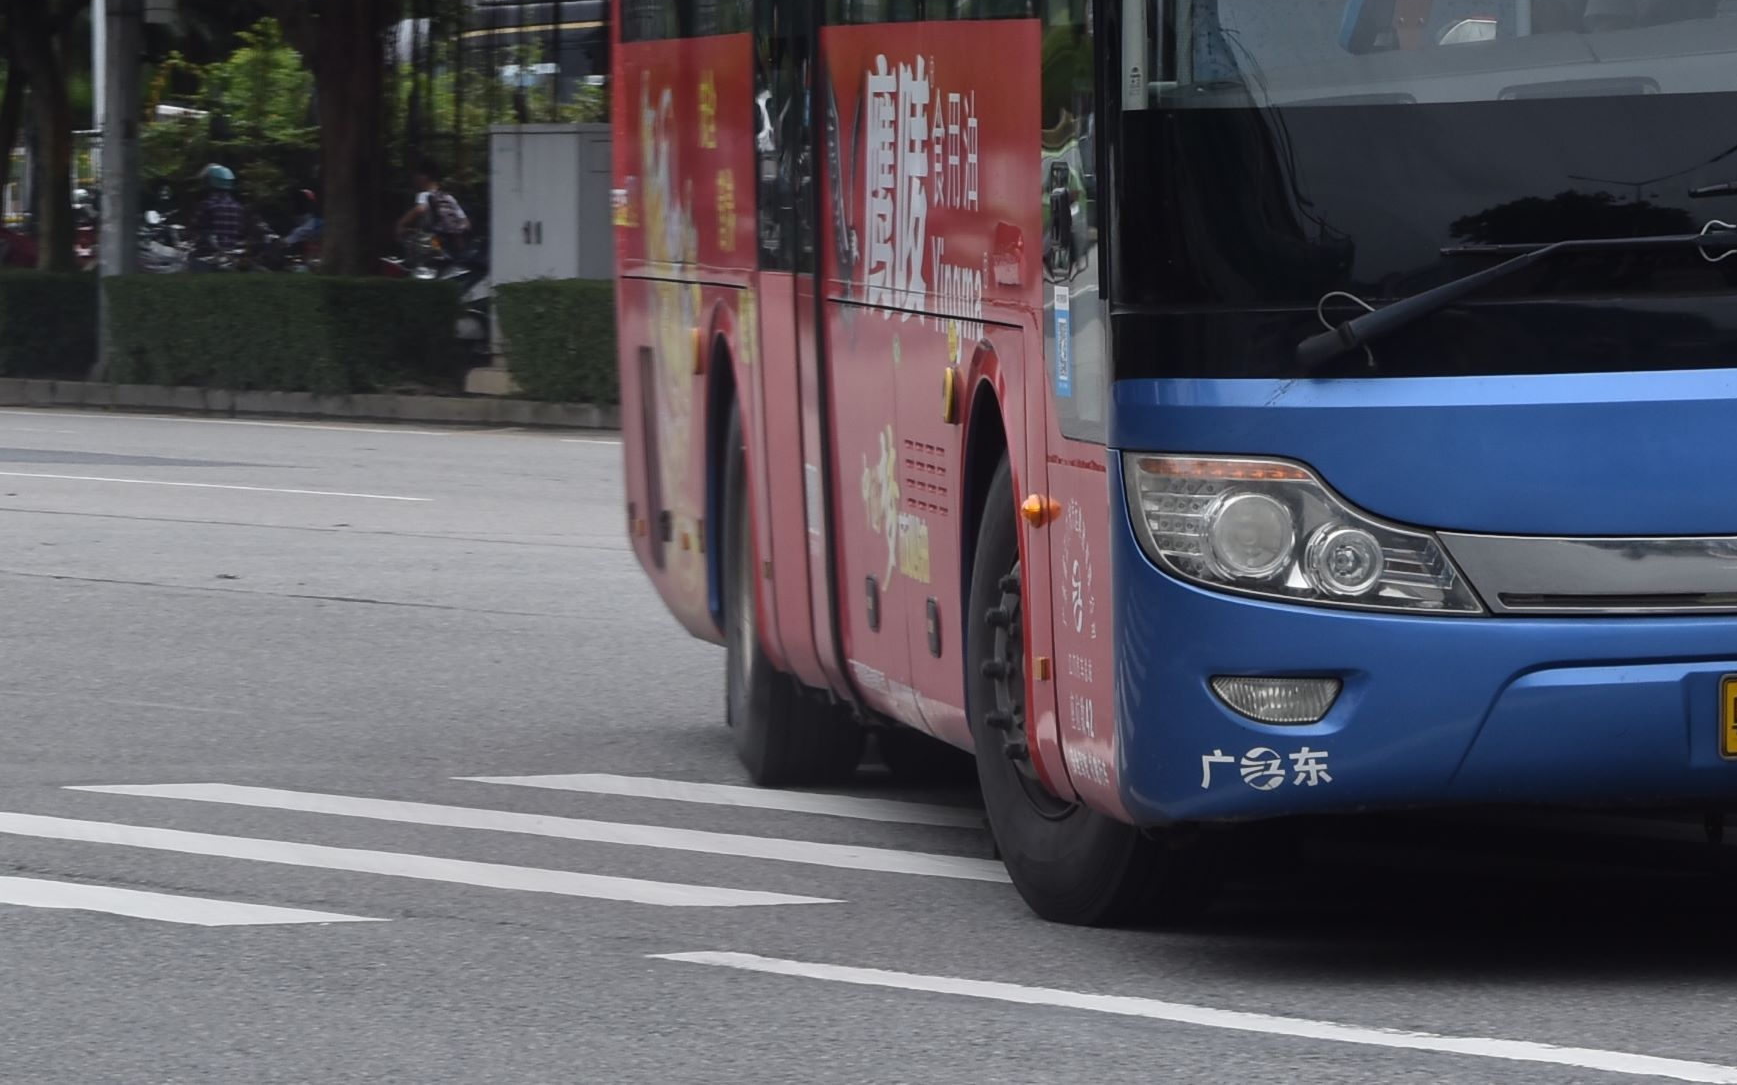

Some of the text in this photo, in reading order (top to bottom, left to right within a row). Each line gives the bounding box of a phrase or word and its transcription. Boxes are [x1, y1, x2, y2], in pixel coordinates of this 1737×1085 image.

[931, 87, 979, 212] 食用油
[932, 236, 984, 365] Yingma
